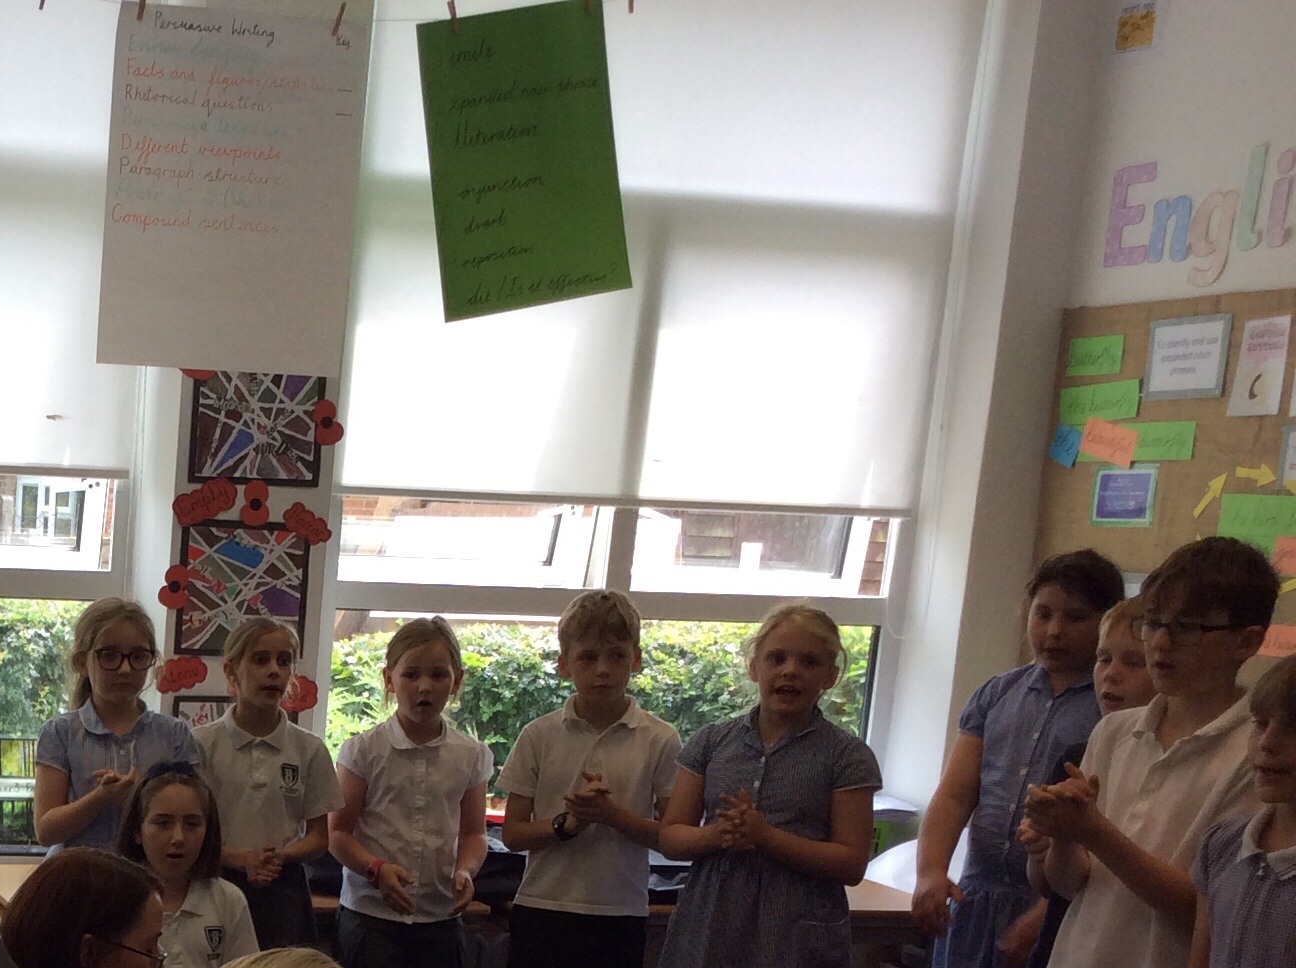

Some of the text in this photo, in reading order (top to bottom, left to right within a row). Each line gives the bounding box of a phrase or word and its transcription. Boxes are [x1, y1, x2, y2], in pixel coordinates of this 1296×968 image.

[154, 11, 223, 35] Persuasive
[232, 18, 276, 48] Writing
[125, 57, 165, 79] Facts
[170, 67, 197, 82] and
[124, 84, 274, 119] Rhetorical questions
[121, 133, 282, 166] Different viewpoints
[119, 155, 284, 188] Paragraph structure
[111, 203, 280, 235] Compound sentences
[1103, 141, 1296, 287] Engli
[176, 485, 230, 514] Empty
